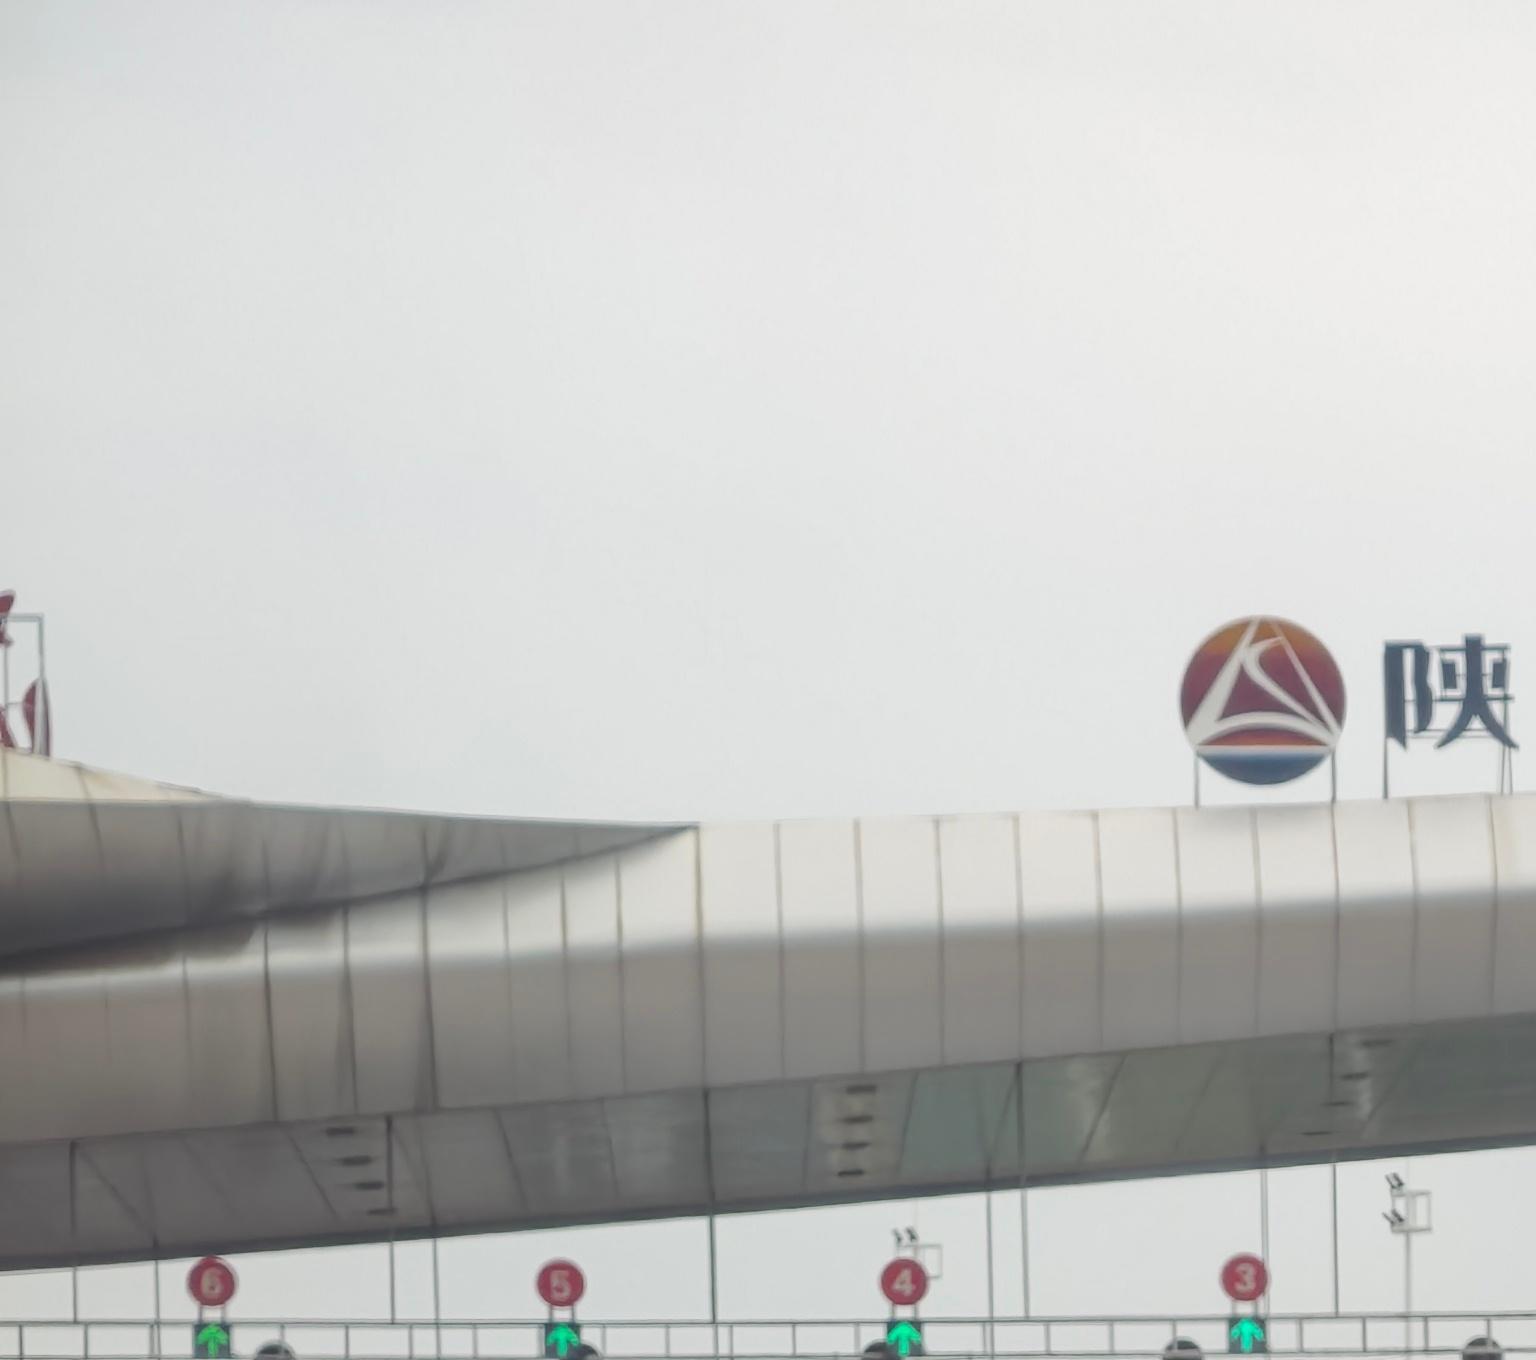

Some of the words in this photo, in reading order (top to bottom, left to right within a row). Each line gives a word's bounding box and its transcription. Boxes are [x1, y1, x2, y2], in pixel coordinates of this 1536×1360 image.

[202, 1270, 222, 1295] 6
[549, 1270, 572, 1299] 5
[891, 1268, 917, 1298] 4
[1235, 1263, 1258, 1292] 3
